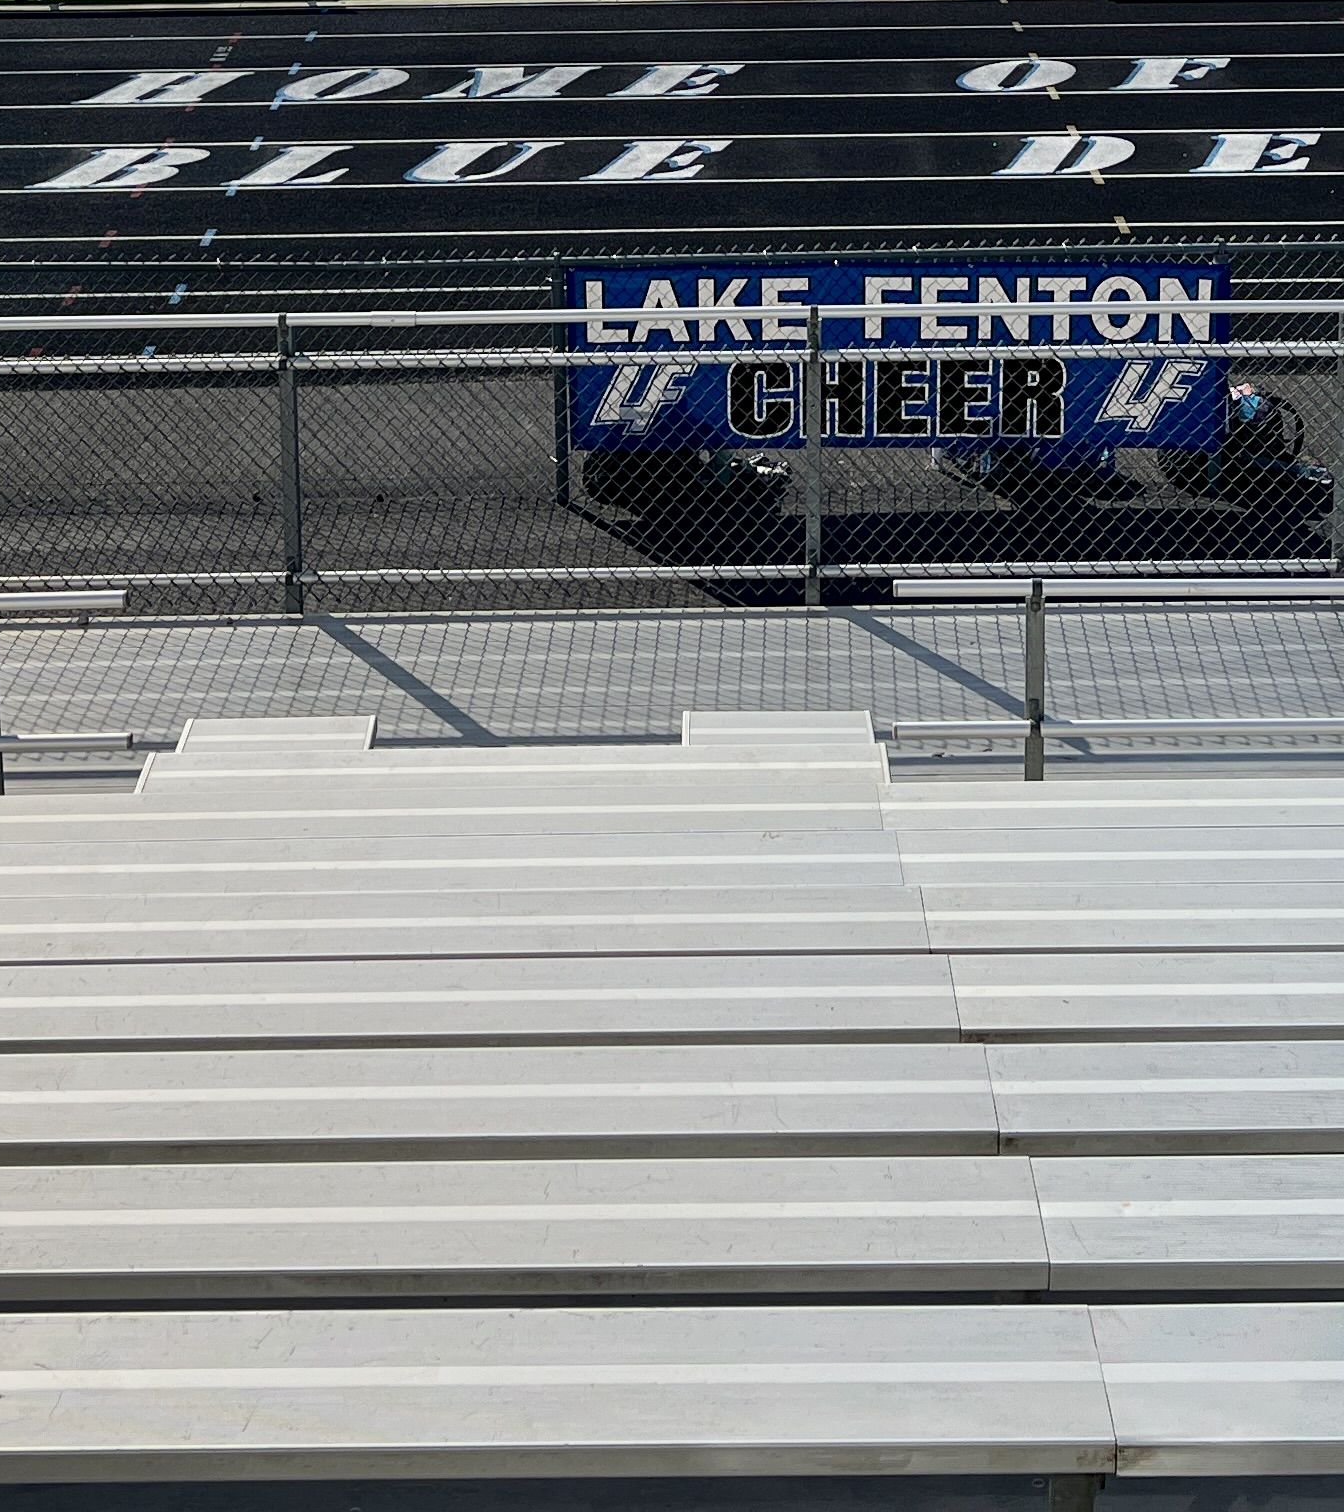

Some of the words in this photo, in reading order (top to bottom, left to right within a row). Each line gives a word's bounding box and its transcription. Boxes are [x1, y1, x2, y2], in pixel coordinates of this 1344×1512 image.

[70, 64, 746, 105] HOME
[955, 57, 1231, 92] OF
[24, 139, 733, 190] BLUE
[584, 276, 810, 344] LAKE
[863, 275, 1213, 342] FENTON
[725, 354, 1067, 440] CHEER
